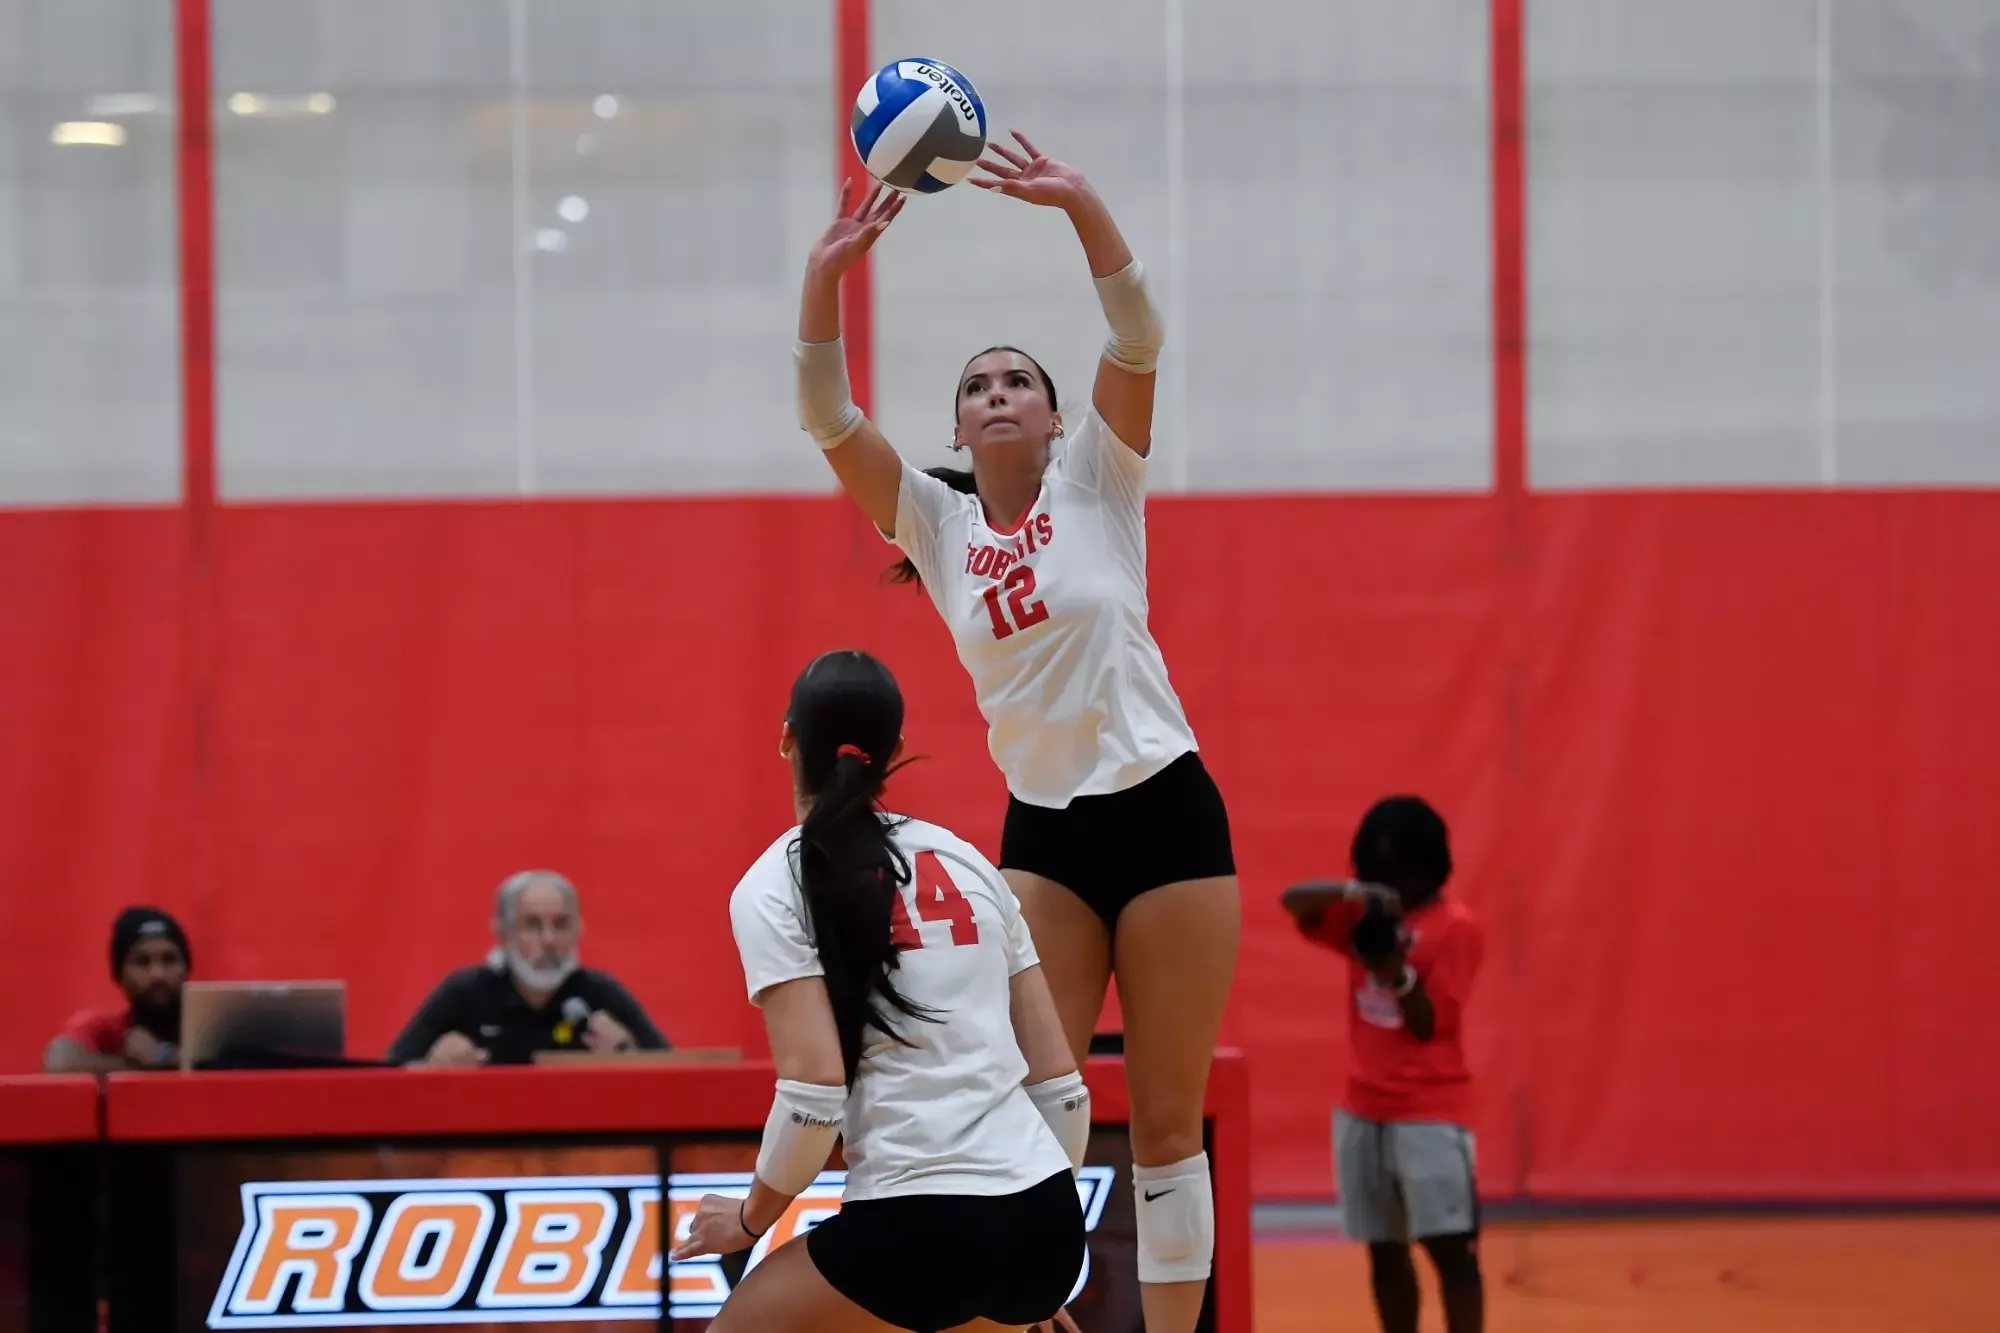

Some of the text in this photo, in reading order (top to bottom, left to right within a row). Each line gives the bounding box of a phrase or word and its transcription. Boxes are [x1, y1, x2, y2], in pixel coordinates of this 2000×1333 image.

[917, 65, 975, 121] molten
[965, 512, 1054, 581] OBTS
[983, 564, 1050, 640] 12
[227, 1185, 850, 1314] ROBE
